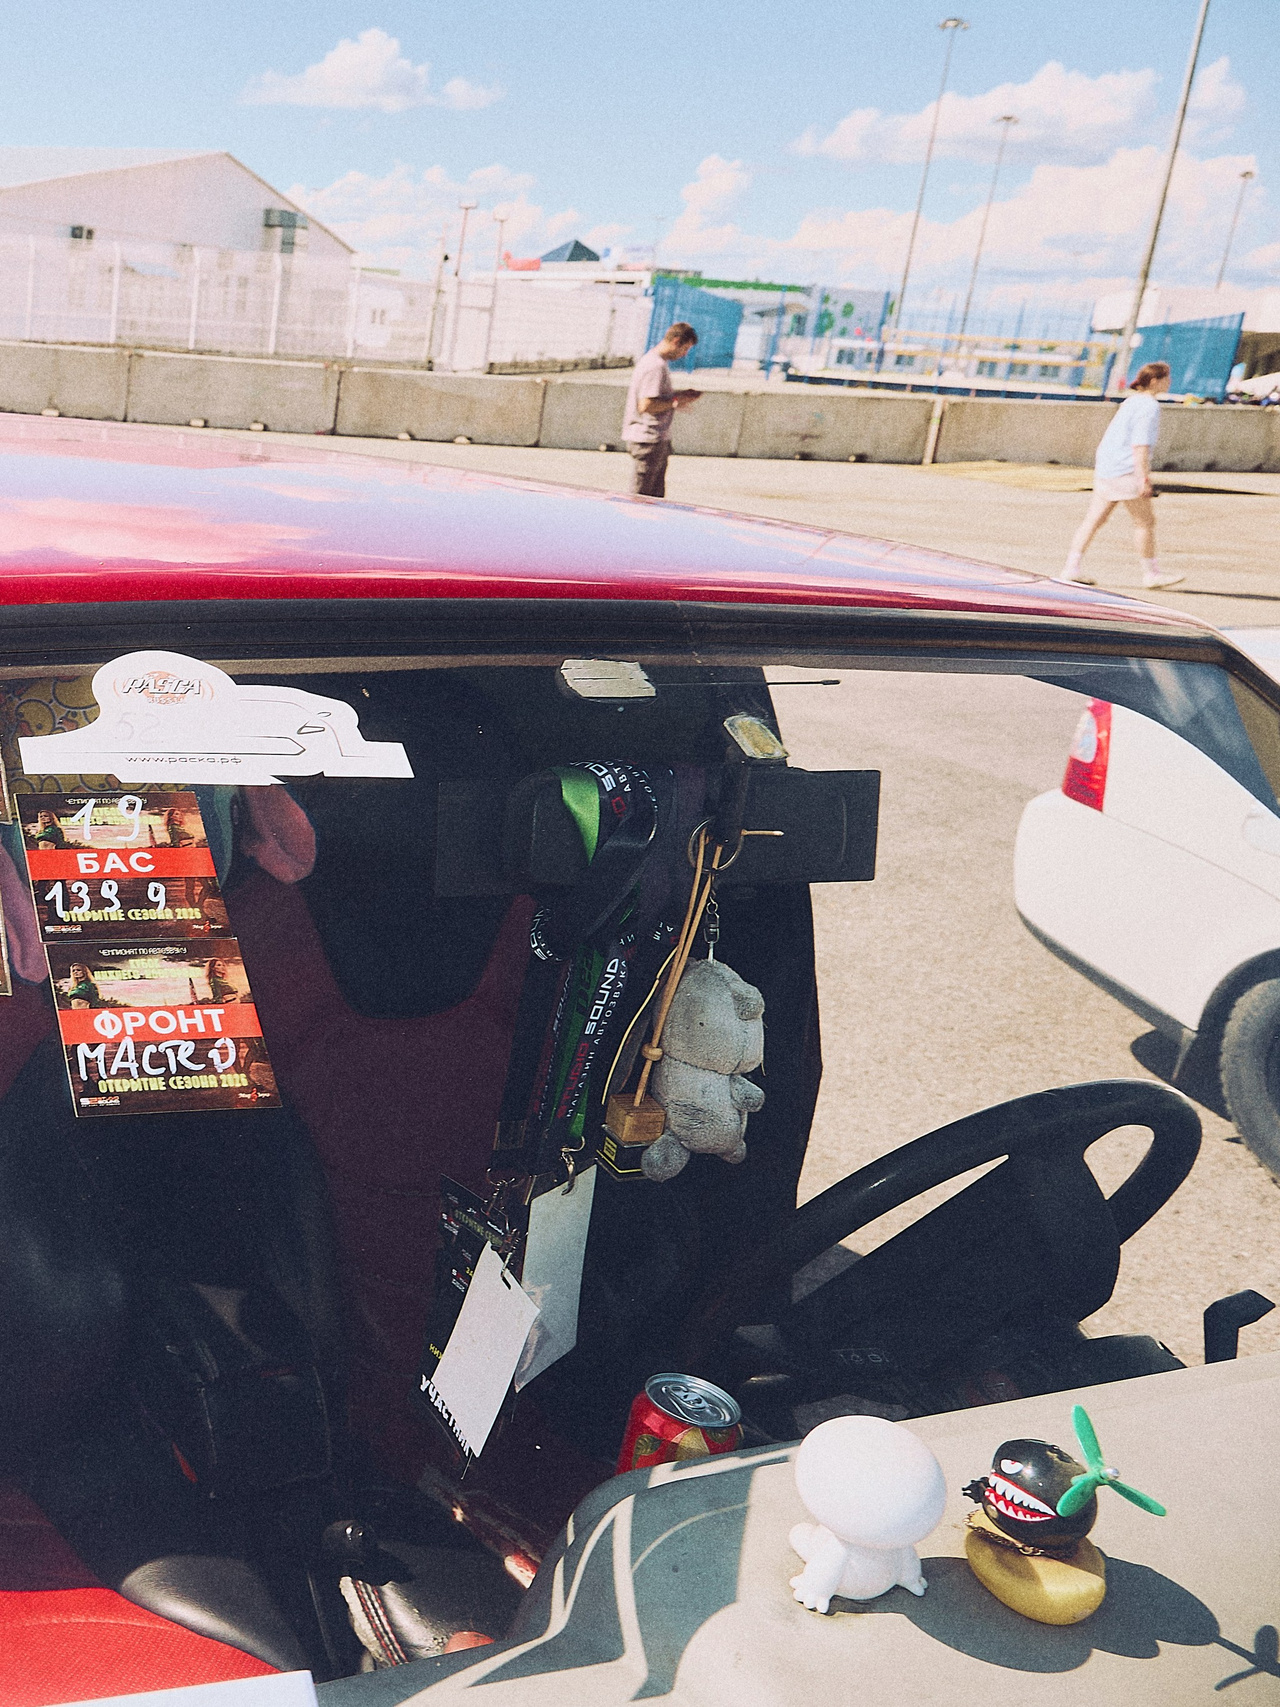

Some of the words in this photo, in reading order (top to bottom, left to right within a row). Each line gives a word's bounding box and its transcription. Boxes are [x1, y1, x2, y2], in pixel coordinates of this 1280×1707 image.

[76, 852, 156, 874] БАС
[584, 957, 620, 1036] SOUND
[593, 959, 629, 1045] АВТОЗВУКА
[93, 1009, 225, 1039] ФРОНТ
[98, 1077, 166, 1093] ОТКРЫТИЕ
[169, 1075, 218, 1090] СЕЗОНА
